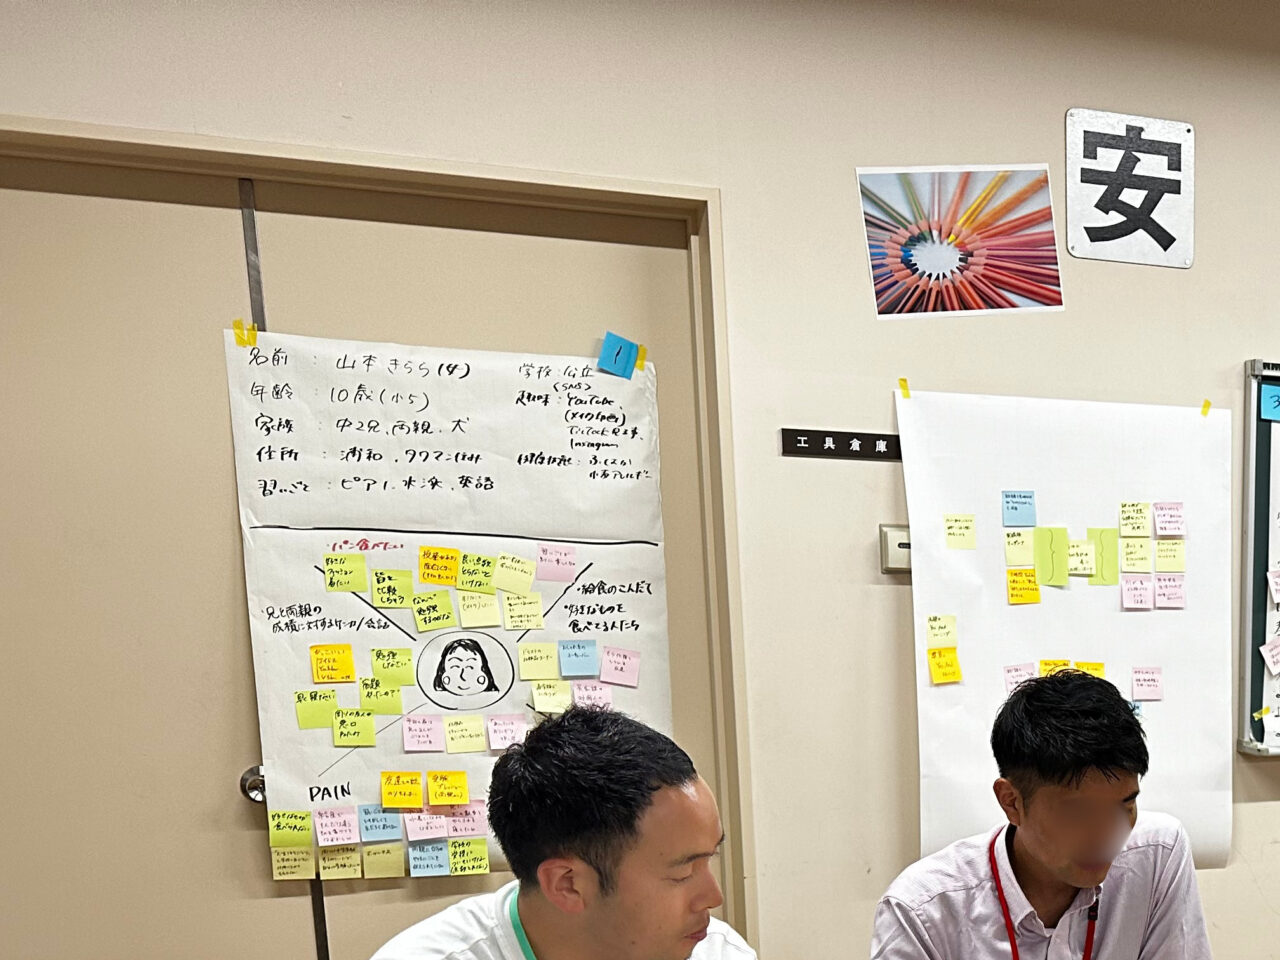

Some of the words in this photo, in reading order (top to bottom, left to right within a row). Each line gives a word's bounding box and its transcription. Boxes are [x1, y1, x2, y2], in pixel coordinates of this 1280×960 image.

[1081, 124, 1182, 252] 安
[796, 436, 889, 455] 工具倉庫
[309, 781, 352, 802] PAIN
